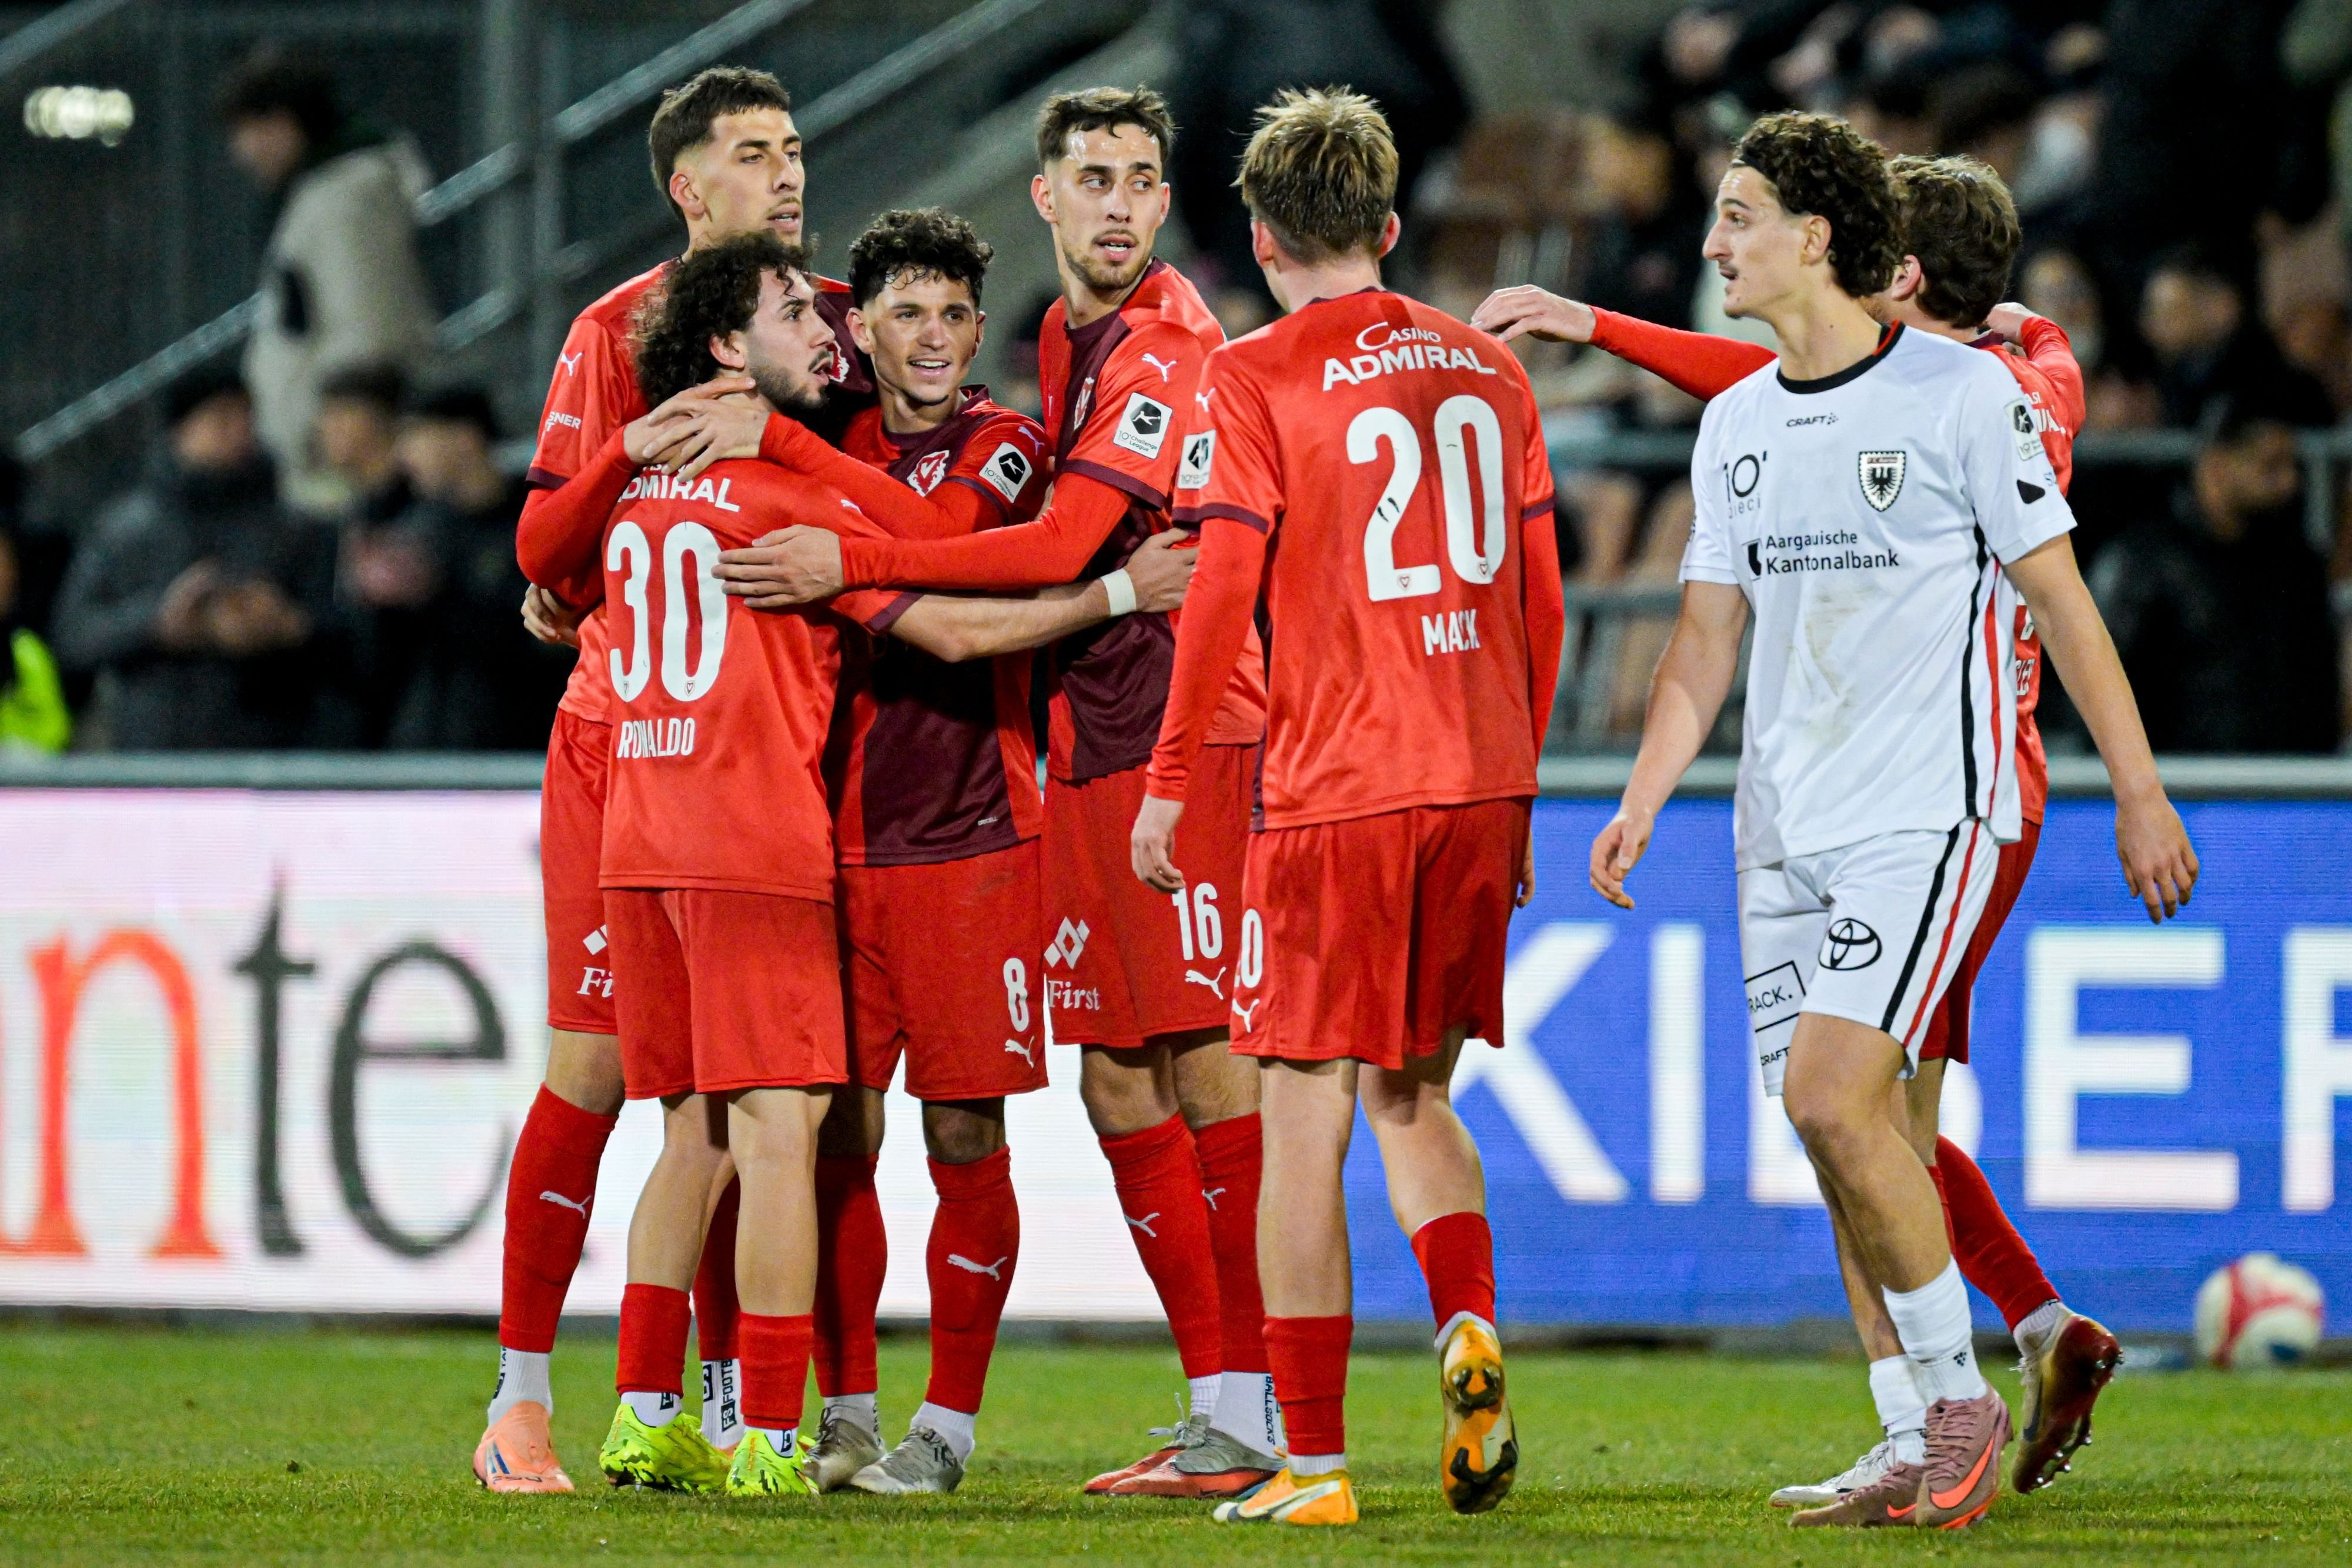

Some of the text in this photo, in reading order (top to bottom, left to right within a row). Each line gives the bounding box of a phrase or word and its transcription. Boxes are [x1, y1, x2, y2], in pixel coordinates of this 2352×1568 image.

[1356, 322, 1441, 350] CASINO
[1322, 345, 1498, 392] ADMIRAL
[1786, 415, 1828, 427] CRAFT
[1129, 440, 1150, 452] League
[1131, 435, 1158, 450] Challenge
[617, 474, 740, 513] DMIRAL
[1346, 394, 1506, 602] 20
[1766, 529, 1857, 551] Aargauische
[1767, 549, 1900, 575] Kantonalbank
[607, 520, 728, 702] 30
[616, 717, 696, 759] RONALDO
[1171, 882, 1223, 961] 16
[1235, 908, 1263, 989] 0
[1003, 957, 1030, 1032] 8
[1048, 979, 1100, 1011] First
[26, 864, 512, 1261] nte
